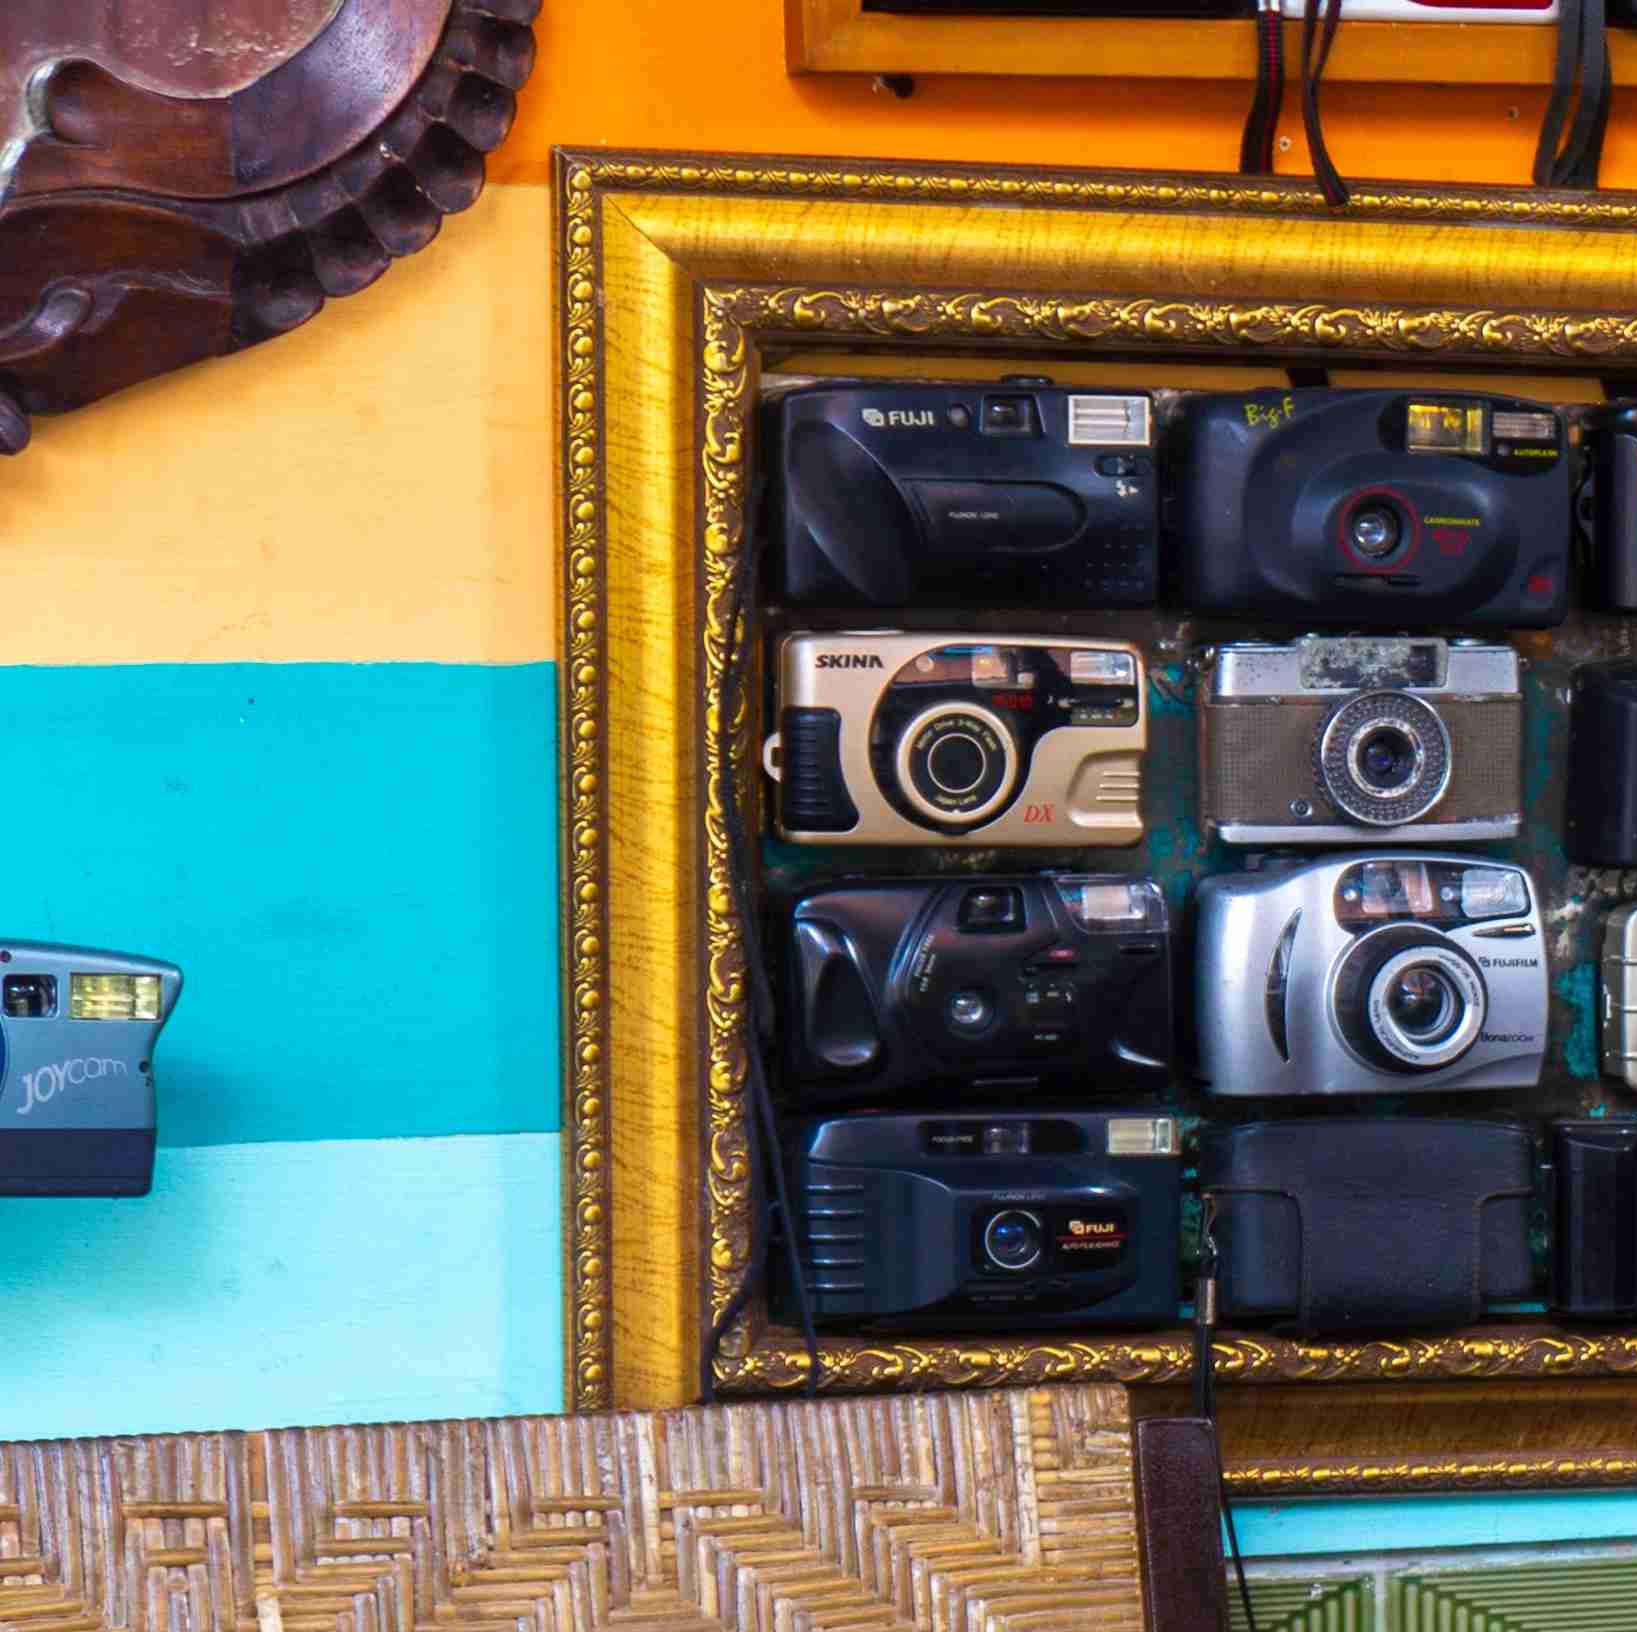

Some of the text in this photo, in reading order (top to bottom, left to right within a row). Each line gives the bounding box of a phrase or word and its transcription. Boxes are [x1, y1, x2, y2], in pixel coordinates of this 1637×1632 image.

[888, 410, 935, 426] FUJI
[814, 654, 884, 670] SKINA
[1022, 803, 1054, 823] DX
[1492, 957, 1539, 969] FUJIFILM
[1086, 1223, 1115, 1234] FUJI
